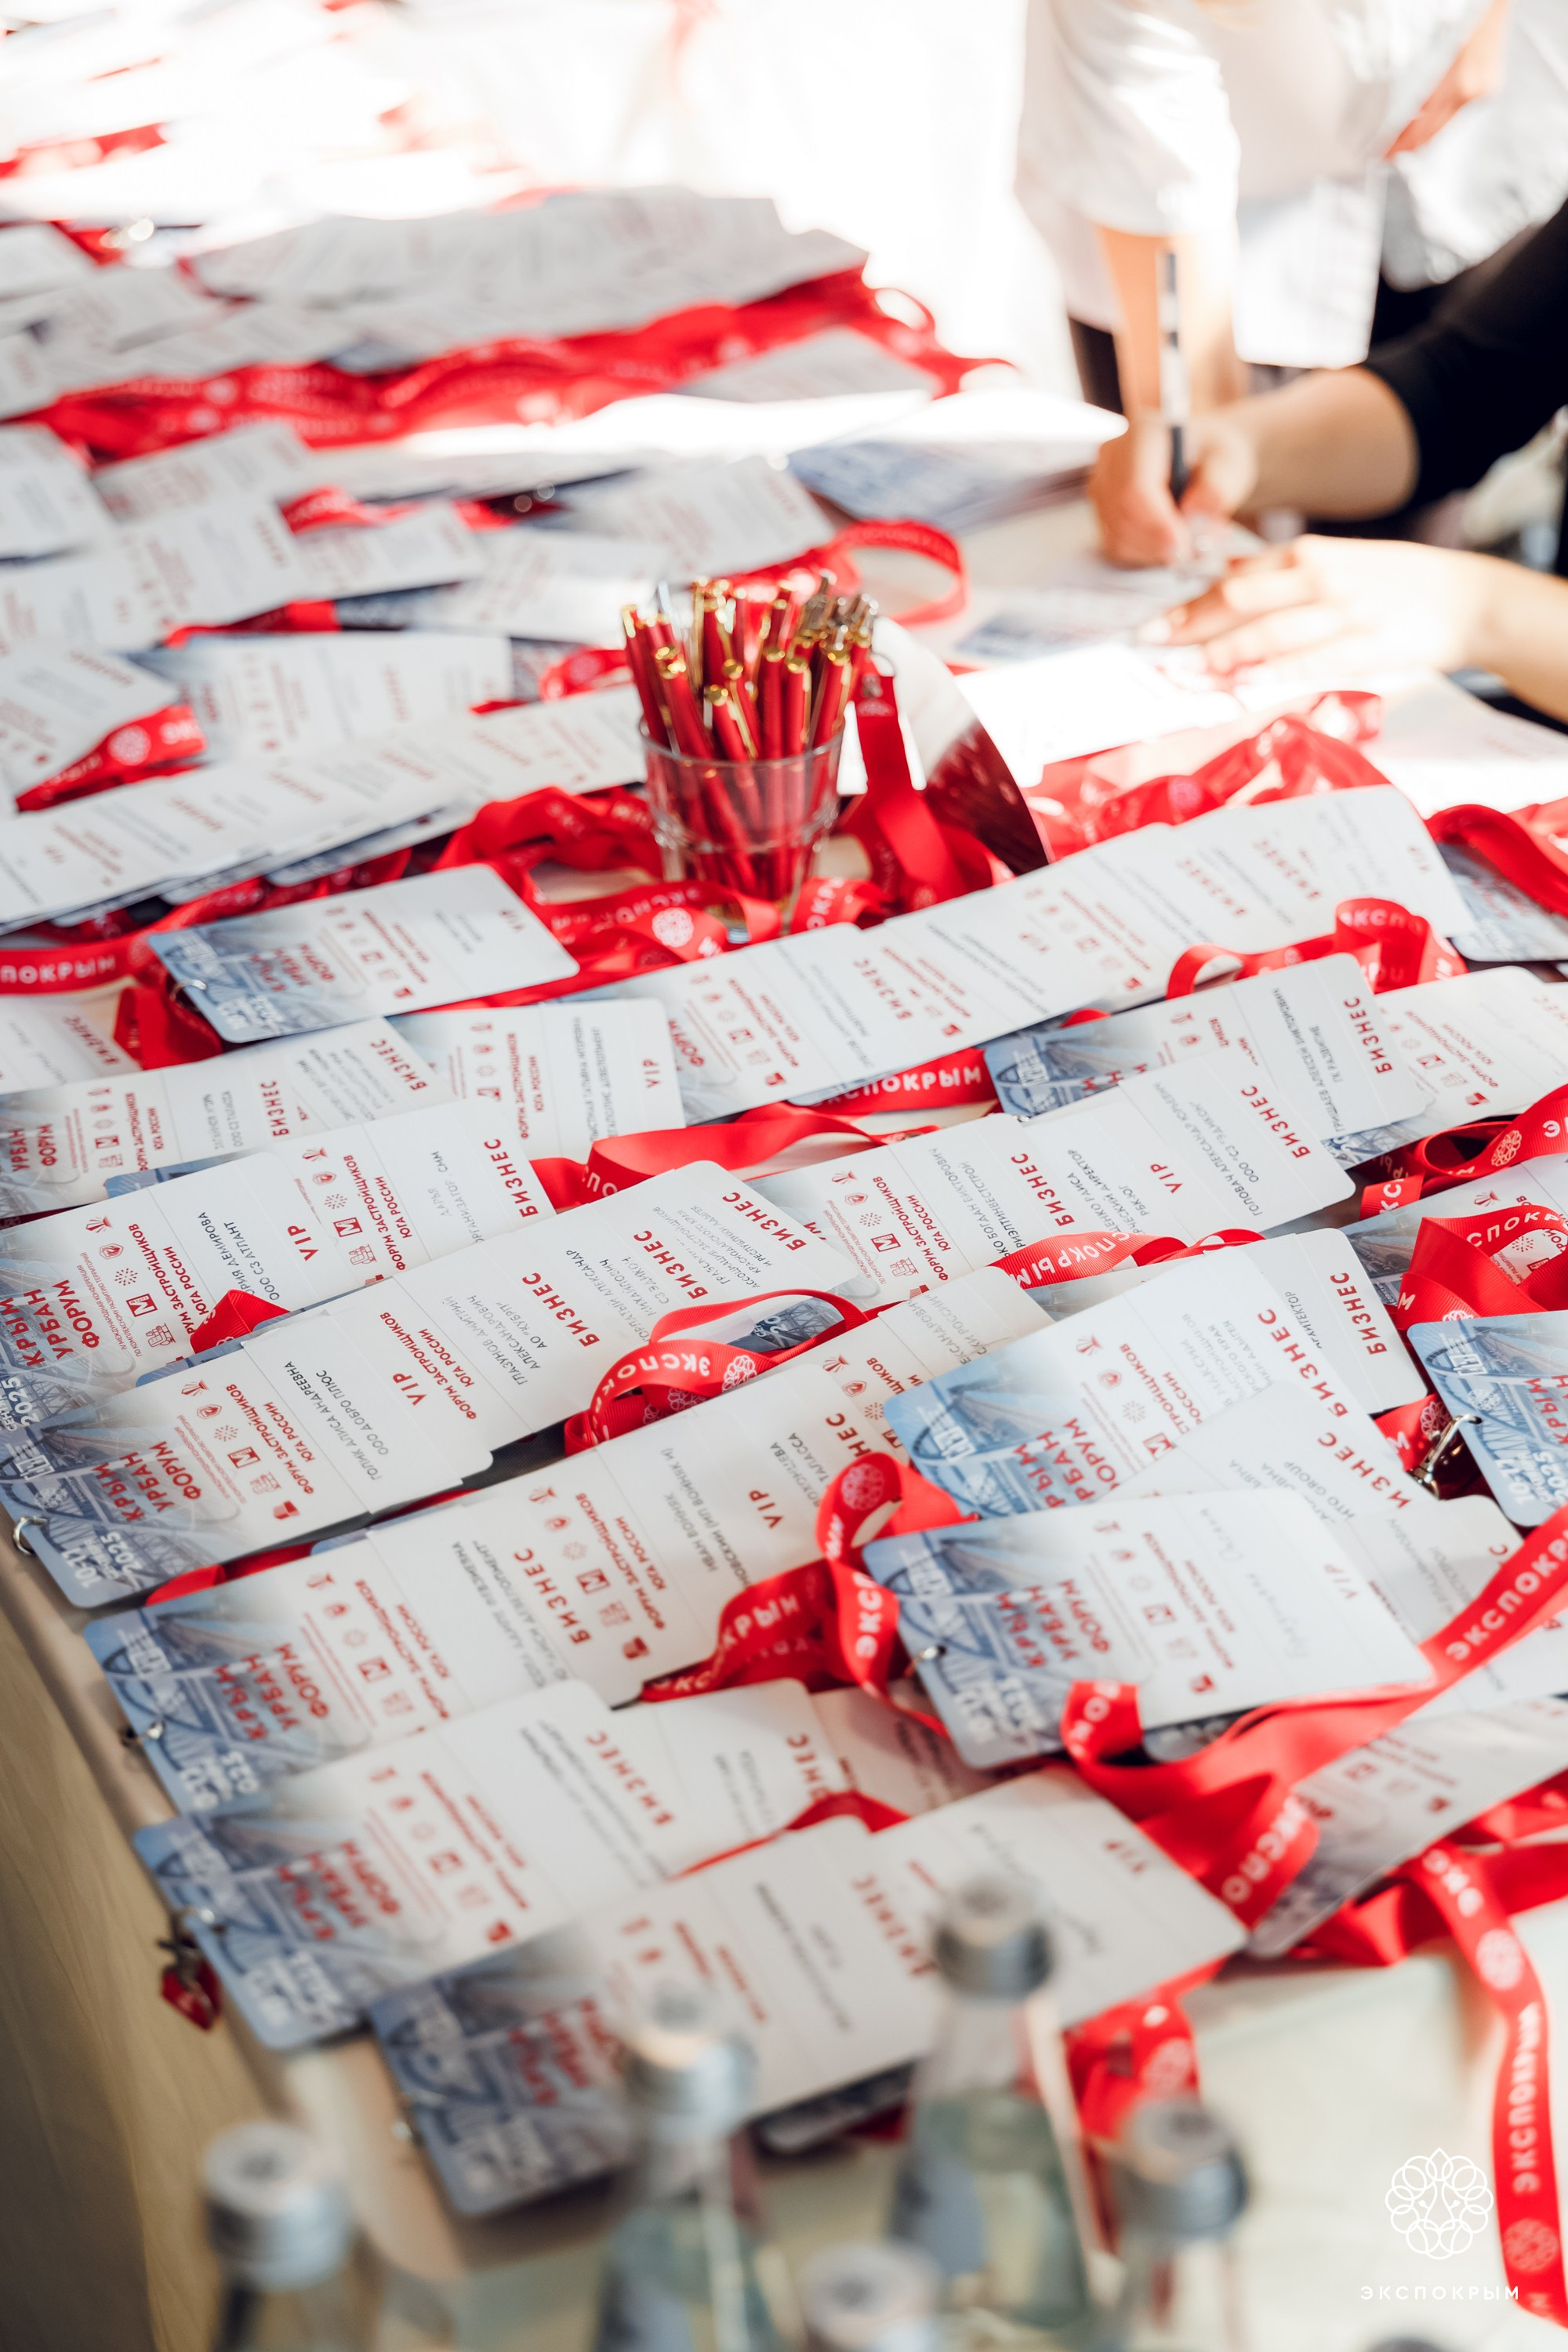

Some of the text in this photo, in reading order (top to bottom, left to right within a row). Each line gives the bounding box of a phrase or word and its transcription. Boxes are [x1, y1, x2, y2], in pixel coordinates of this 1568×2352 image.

[0, 956, 116, 984] ПОКРЫМ
[370, 1038, 427, 1091] БИЗНЕС
[1344, 996, 1393, 1075] БИЗНЕС
[261, 1080, 289, 1137] БИЗНЕС
[825, 1065, 981, 1102] СПОКРЫМ
[8, 1127, 31, 1172] УРБАН
[37, 1123, 59, 1167] ФОРУМ
[1184, 1123, 1229, 1173] АЛЕКСАНДР
[1241, 1085, 1312, 1160] БИЗНЕС
[484, 1139, 539, 1218] БИЗНЕС
[929, 1147, 998, 1240] БОГДАН ВИКТОРОВИЧ
[1011, 1153, 1075, 1227] БИЗНЕС
[1067, 1149, 1109, 1192] ДИРЕКТОР
[1149, 1163, 1184, 1193] VIP
[1224, 1174, 1264, 1217] ГОЛОВАЧ
[343, 1155, 406, 1271] ФОРУМ ЗАСТРОЙЩИКОВ
[374, 1176, 412, 1239] ЮГА РОССИИ
[722, 1192, 808, 1251] БИЗНЕС
[873, 1176, 949, 1280] ФОРУМ ЗАСТРОЙЩИКОВ
[906, 1194, 952, 1251] ЮГА РОССИИ
[80, 1252, 102, 1283] ТЕРРИТОРИЙ
[198, 1212, 240, 1268] ДЕМИРОВА
[223, 1221, 281, 1301] ООО СЗ АТЛАНТ
[287, 1225, 319, 1261] VIP
[634, 1230, 709, 1300] БИЗНЕС
[652, 1206, 760, 1290] АССОЦИАЦИЯ ЗАСТРОЙЩИКОВ
[720, 1225, 767, 1262] РЕСПУБЛИКИ
[1009, 1232, 1131, 1287] СПОКРЫМ
[77, 1264, 102, 1304] КОНФЕРЕНЦИЯ
[100, 1281, 118, 1308] РАЗВИТИЮ
[128, 1223, 197, 1335] РУМ ЗАСТРОЙЩИКОВ
[162, 1247, 209, 1316] ЮГА РОССИИ
[522, 1272, 601, 1348] БИЗНЕС
[0, 1297, 45, 1367] КРЫМ
[23, 1288, 74, 1360] УРБАН
[53, 1279, 100, 1348] ФОРУМ
[99, 1304, 125, 1345] МЕЖДУНАРОДНАЯ
[114, 1308, 138, 1348] КОМПЛЕКСНОМУ
[441, 1295, 529, 1386] ГЛАЗУНОВ ДМИТРИЙ
[467, 1294, 542, 1371] АЛЕКСАНДРОВИЧ
[530, 1335, 549, 1350] АО
[1330, 1272, 1388, 1356] БИЗНЕС
[380, 1312, 477, 1420] ФОРУМ ЗАСТРОЙЩИКОВ
[393, 1373, 427, 1406] VIP
[419, 1328, 474, 1388] ЮГА РОССИИ
[1120, 1343, 1190, 1435] СТРОЙЩИКОВ
[1258, 1308, 1348, 1417] БИЗНЕС
[2, 1376, 40, 1425] 2025
[283, 1361, 383, 1481] ГОЛИК АЛИСА АНДРЕЕВНА
[316, 1370, 389, 1456] ООО ДОБРО ПЛЮС
[1162, 1370, 1203, 1426] РОССИИ
[226, 1383, 314, 1494] ФОРУМ ЗАСТРОЙЩИКОВ
[263, 1401, 315, 1461] ЮГА РОССИИ
[788, 1432, 829, 1483] ТАЛАССА
[825, 1412, 873, 1458] НЕС
[1063, 1417, 1121, 1490] ОРУМ
[93, 1462, 145, 1523] КРЫМ
[119, 1452, 176, 1512] УРБАН
[150, 1441, 202, 1500] ФОРУМ
[1012, 1443, 1065, 1508] РЫМ
[1036, 1430, 1096, 1501] РБАН
[1318, 1432, 1412, 1509] ИЗНЕС
[575, 1492, 640, 1586] ЗАСТРОЙЩИКОВ
[615, 1515, 651, 1564] РОССИИ
[749, 1489, 785, 1530] VIP
[100, 1532, 143, 1574] 2025
[693, 1535, 719, 1573] ИВАН
[514, 1548, 592, 1645] БИЗНЕС
[1446, 1529, 1568, 1661] ЭКСПОКР
[213, 1664, 268, 1740] КРЫМ
[241, 1653, 299, 1731] УРБАН
[274, 1642, 329, 1718] ФОРУМ
[1508, 2000, 1542, 2195] ЭКСПОКРЫМ
